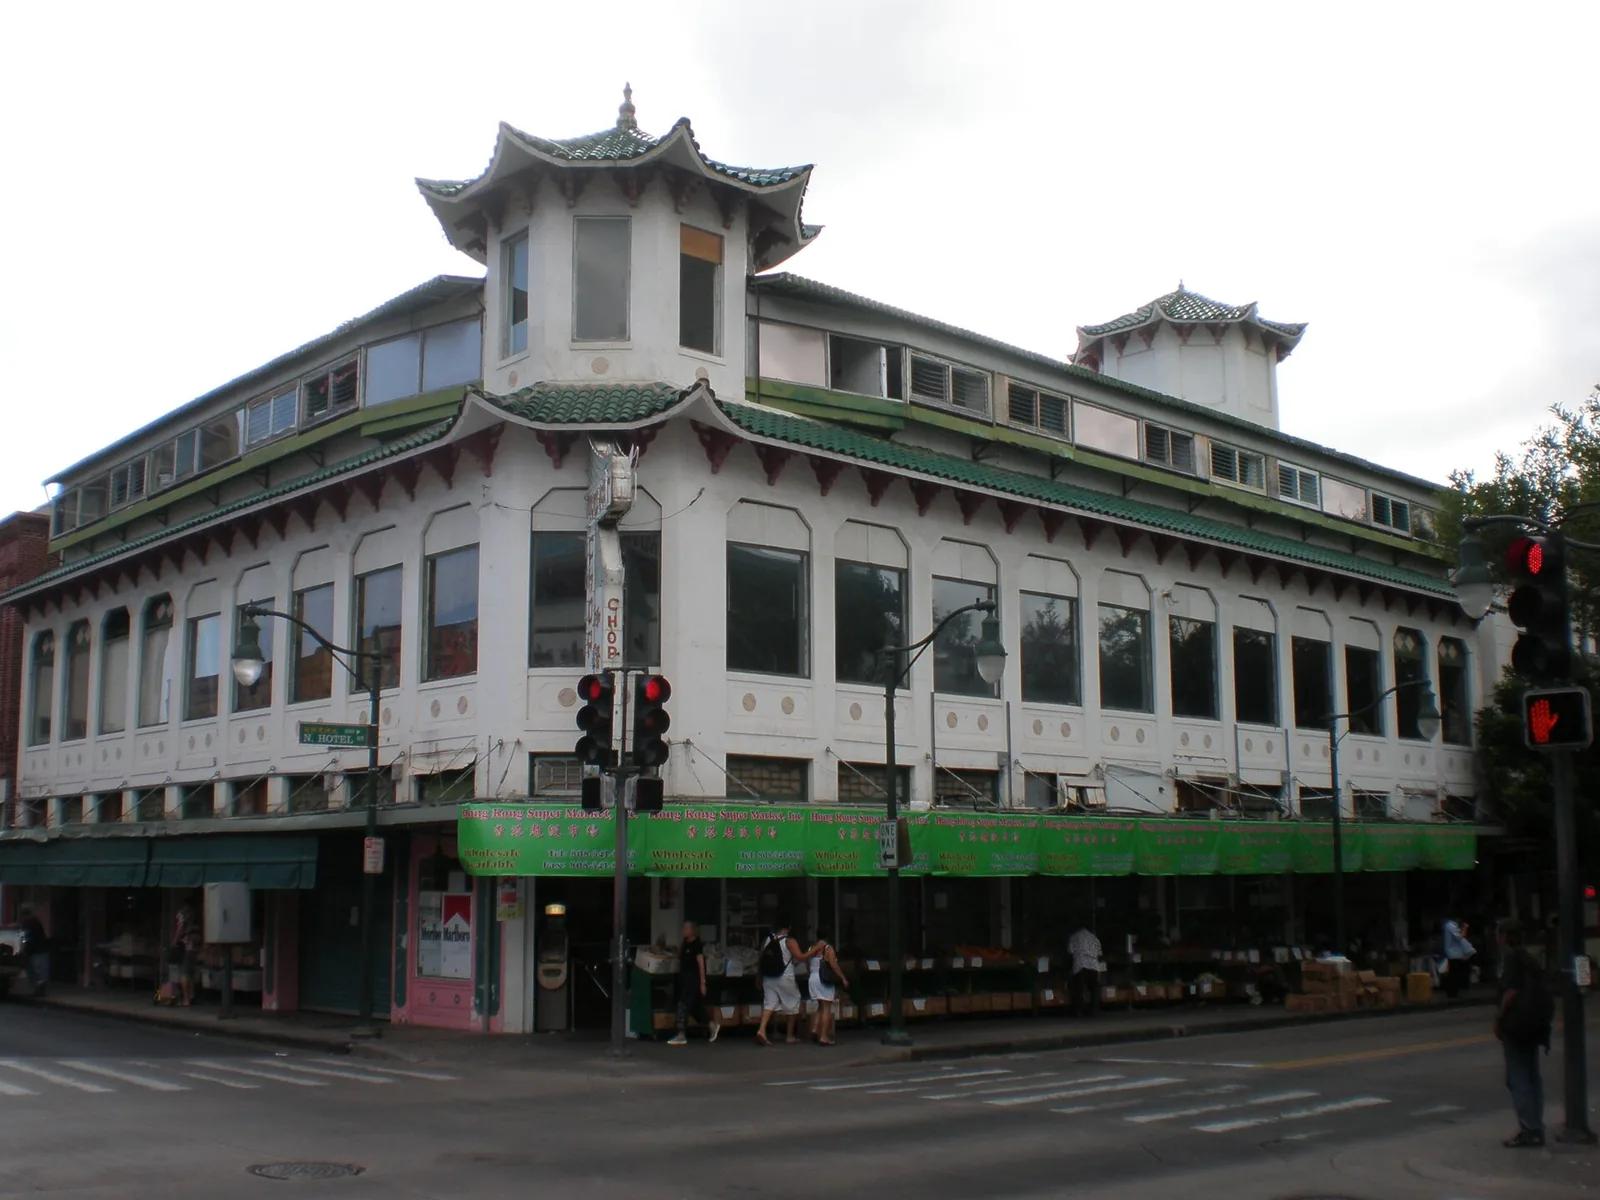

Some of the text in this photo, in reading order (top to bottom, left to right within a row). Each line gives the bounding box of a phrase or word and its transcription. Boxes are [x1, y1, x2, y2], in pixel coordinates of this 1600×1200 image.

[607, 598, 620, 660] CHOP
[303, 734, 314, 742] N.
[318, 734, 354, 745] HOTEL
[493, 808, 524, 821] Kong
[527, 808, 562, 821] Super
[684, 810, 716, 822] Kong
[720, 810, 748, 822] Super
[811, 812, 834, 824] Hong
[835, 812, 857, 824] Kong
[881, 824, 895, 836] ONE
[881, 838, 895, 849] WAY
[651, 849, 715, 859] Wholesale
[814, 851, 860, 860] Wholesale
[653, 861, 710, 871] Available
[816, 862, 858, 871] Available
[443, 924, 470, 942] Marlboro
